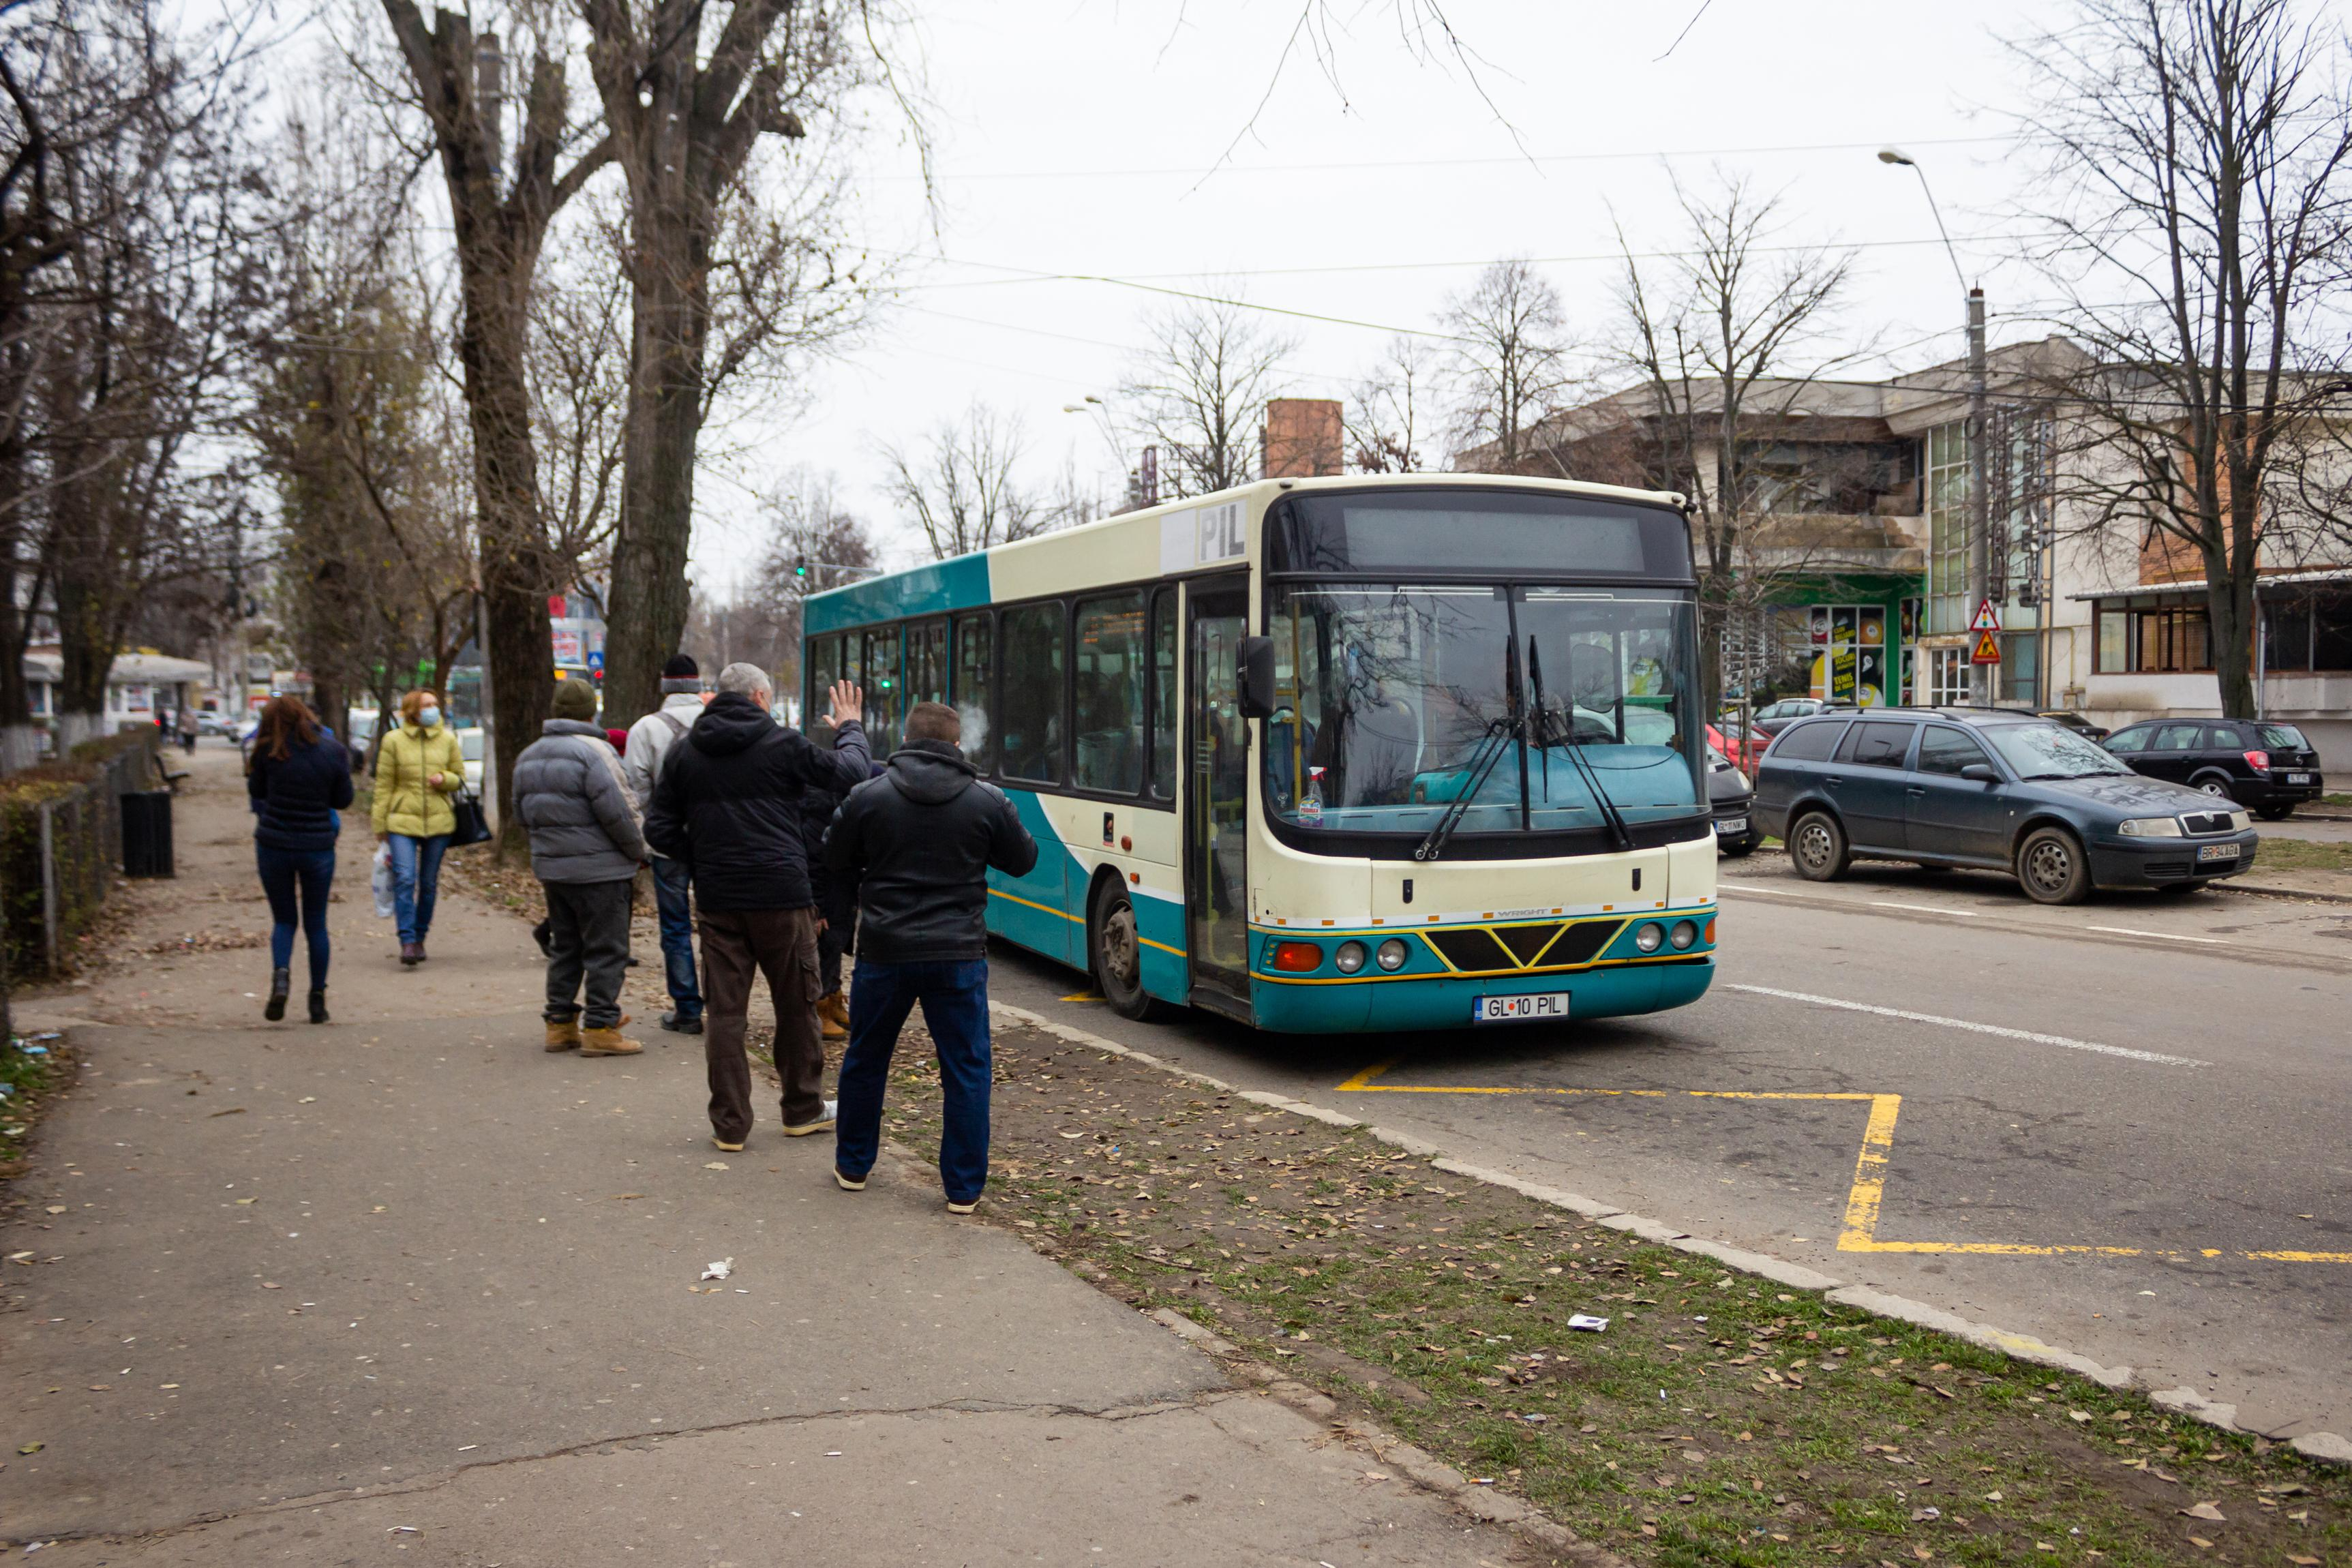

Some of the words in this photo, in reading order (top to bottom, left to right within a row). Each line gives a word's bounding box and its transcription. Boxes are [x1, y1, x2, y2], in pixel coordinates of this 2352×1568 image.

[1201, 504, 1244, 560] PIL
[1833, 672, 1853, 684] TENIS
[1719, 822, 1726, 831] GL
[2203, 847, 2212, 858] BR
[1498, 909, 1548, 917] WRIGHT
[1489, 999, 1509, 1016] GL
[1516, 998, 1531, 1015] 10
[1537, 997, 1561, 1014] PIL
